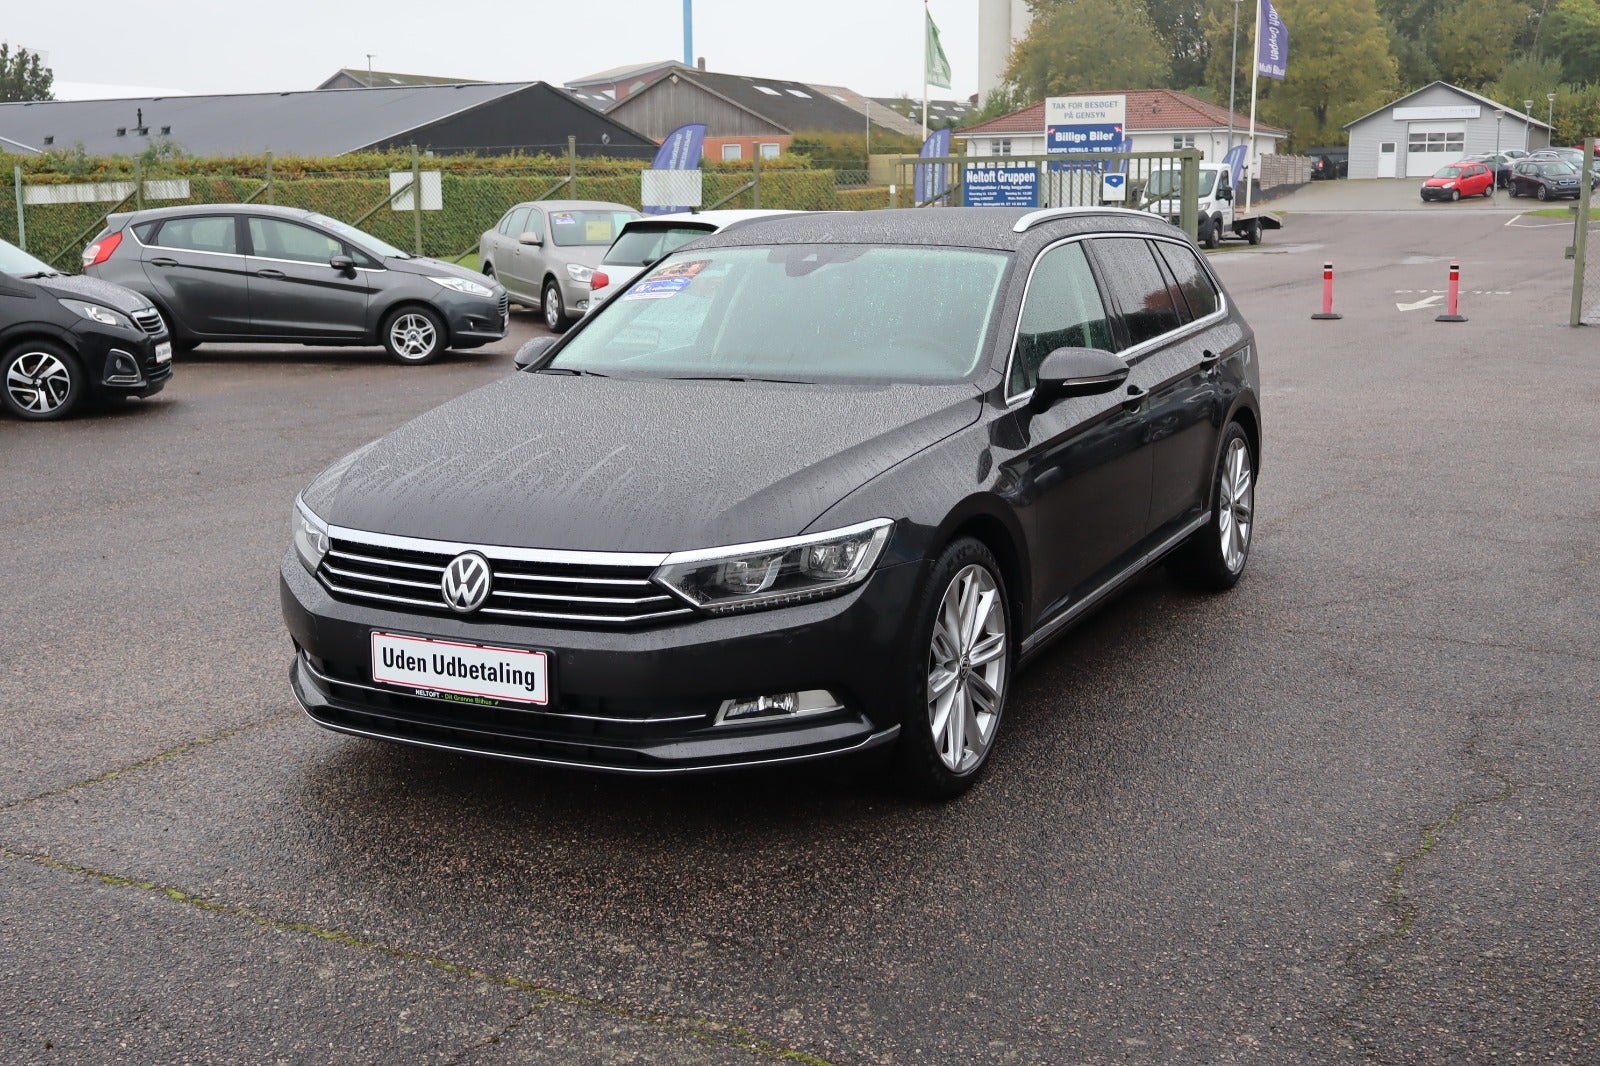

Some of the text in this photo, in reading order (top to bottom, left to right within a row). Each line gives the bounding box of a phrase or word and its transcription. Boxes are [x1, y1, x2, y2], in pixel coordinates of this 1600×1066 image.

[1084, 100, 1118, 109] BESØGET
[1064, 111, 1106, 119] PÅ GENSYN
[1055, 131, 1114, 143] Billige Biler
[966, 170, 1035, 185] Neltoft Gruppen
[382, 646, 535, 692] Uden Udbetaling
[415, 688, 440, 698] NELTOFT
